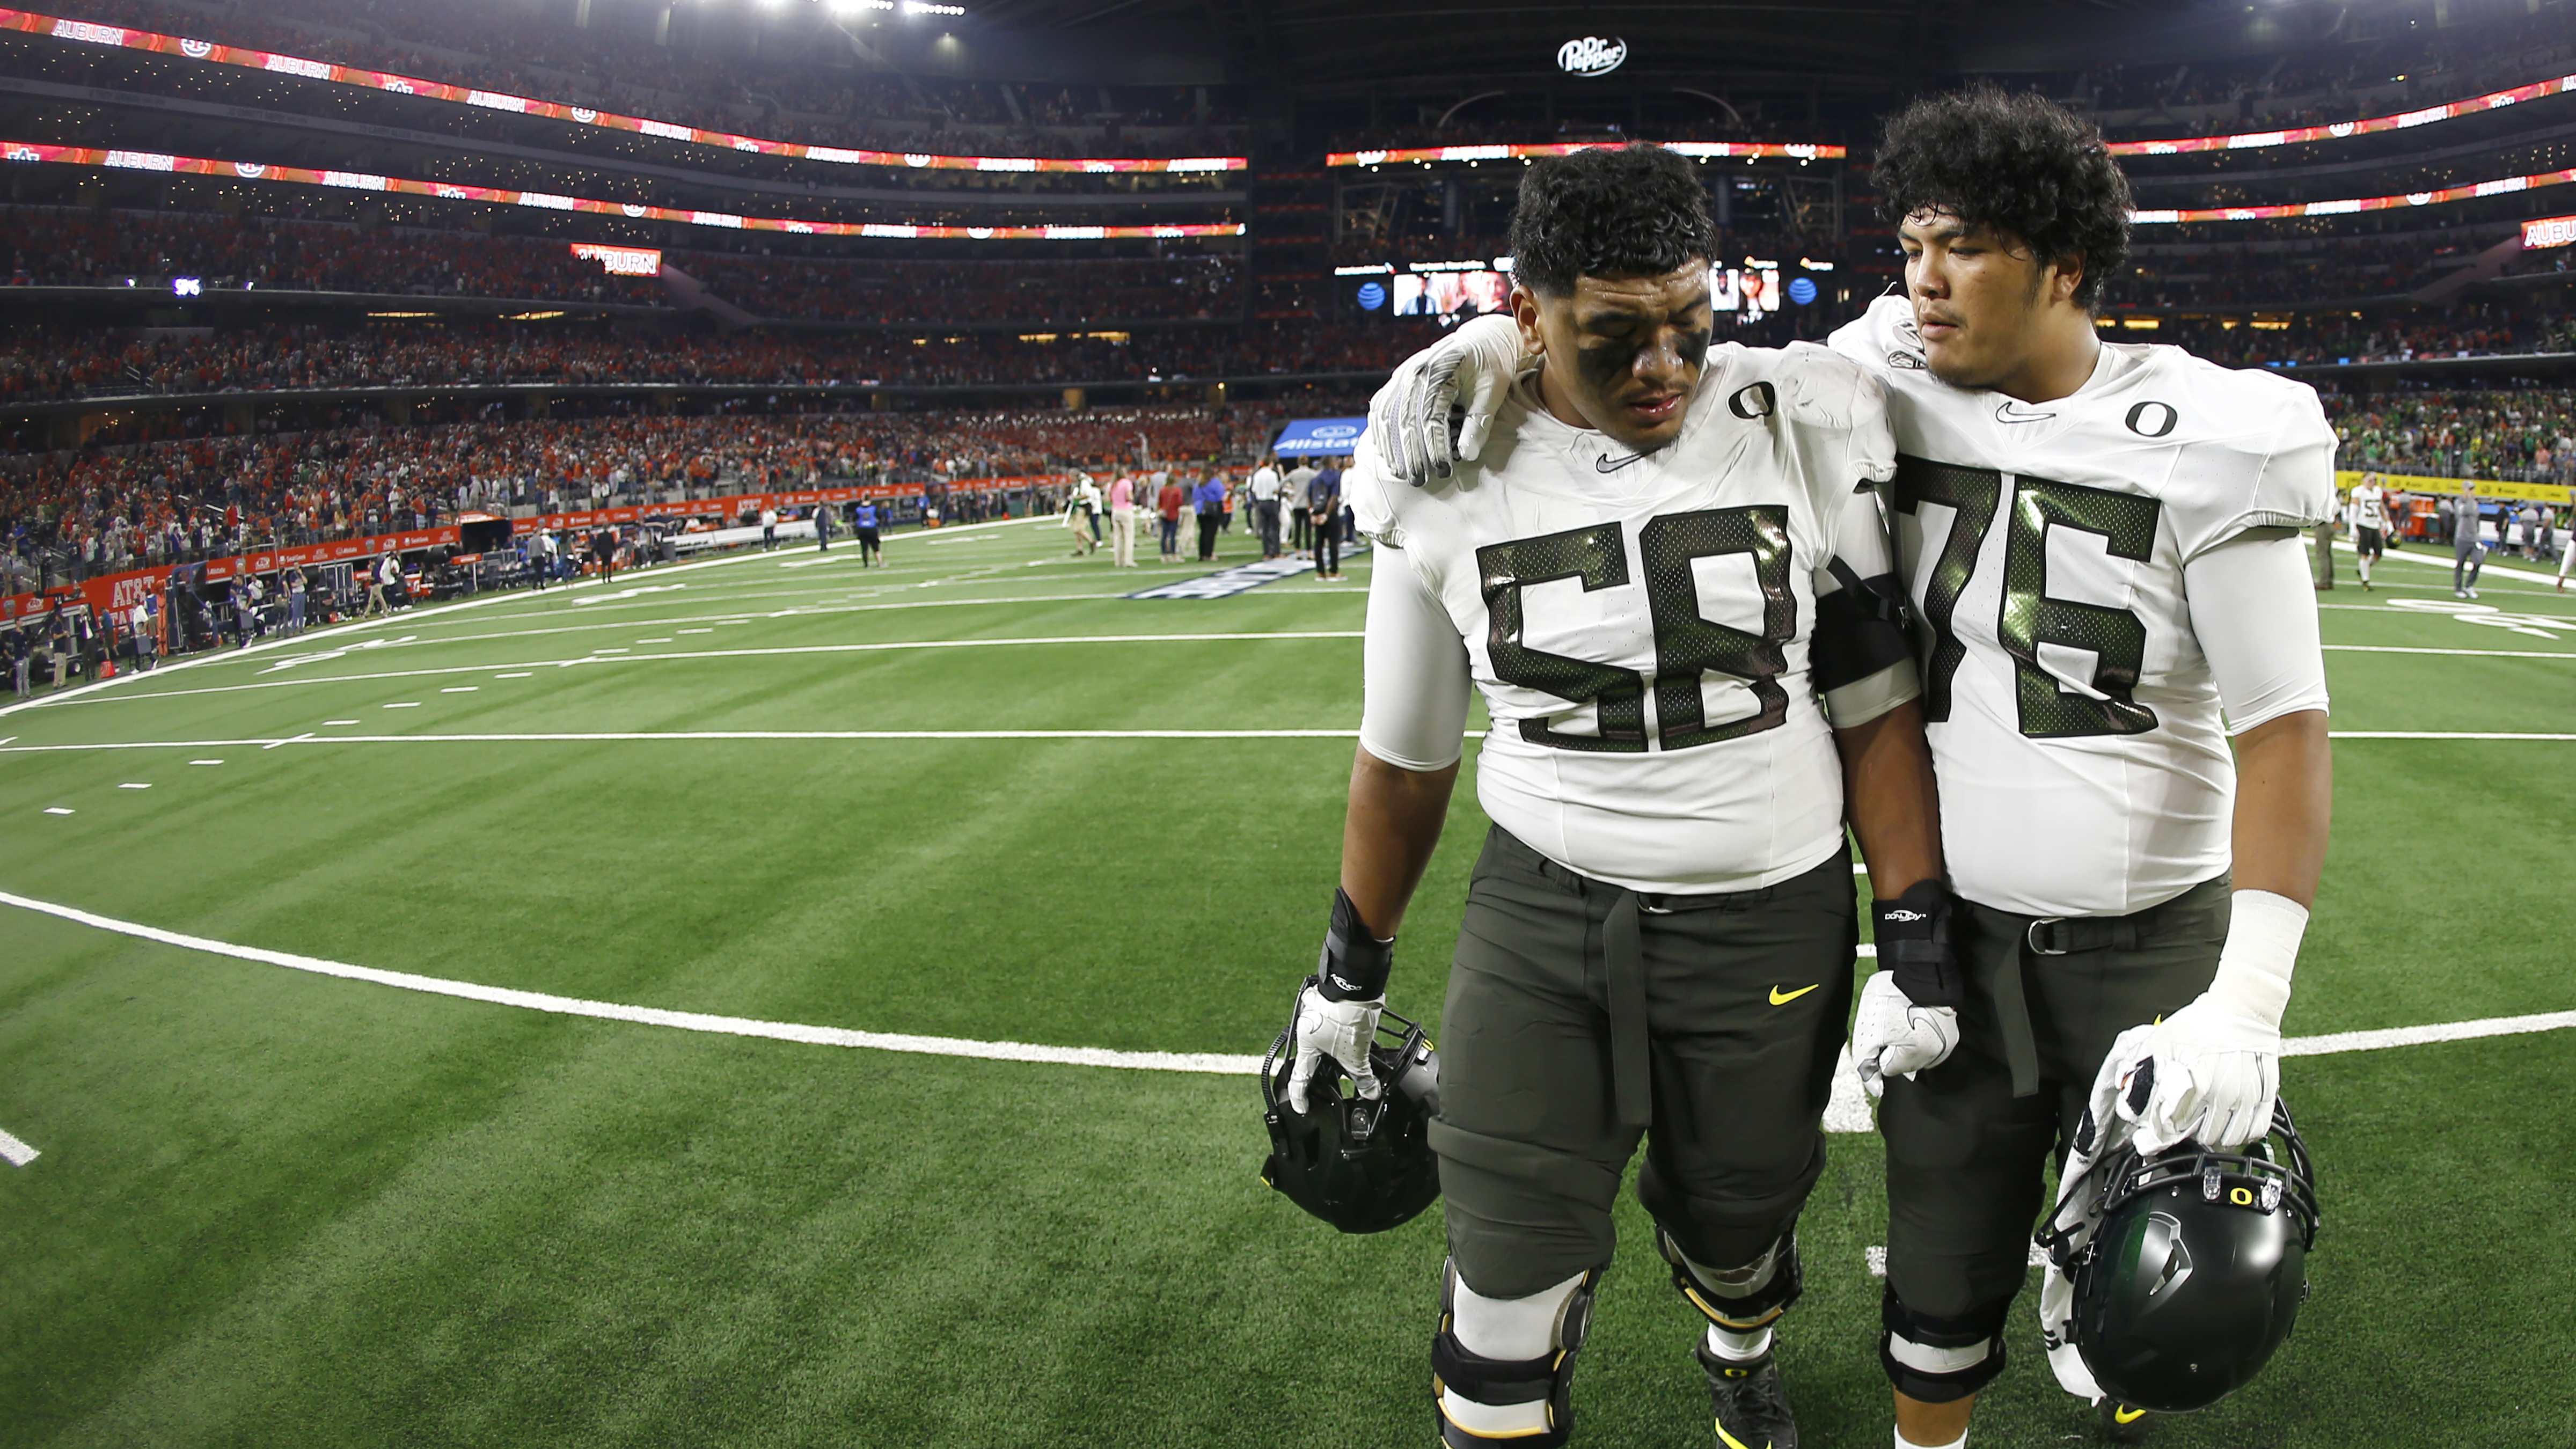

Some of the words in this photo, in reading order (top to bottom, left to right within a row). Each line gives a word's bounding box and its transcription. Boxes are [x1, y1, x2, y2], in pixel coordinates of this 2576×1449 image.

[52, 19, 124, 46] AUBURN
[1557, 40, 1622, 72] Pepper
[1583, 36, 1608, 55] Dr
[265, 54, 331, 80] AUBURN
[466, 90, 525, 113] AUBURN
[105, 151, 174, 172] AUBURN
[323, 171, 385, 191] AUBURN
[518, 192, 573, 210] AUBURN
[1273, 437, 1358, 450] Allstat
[112, 576, 155, 608] AT&T
[1894, 453, 2162, 738] 76
[1476, 504, 1797, 752] 58
